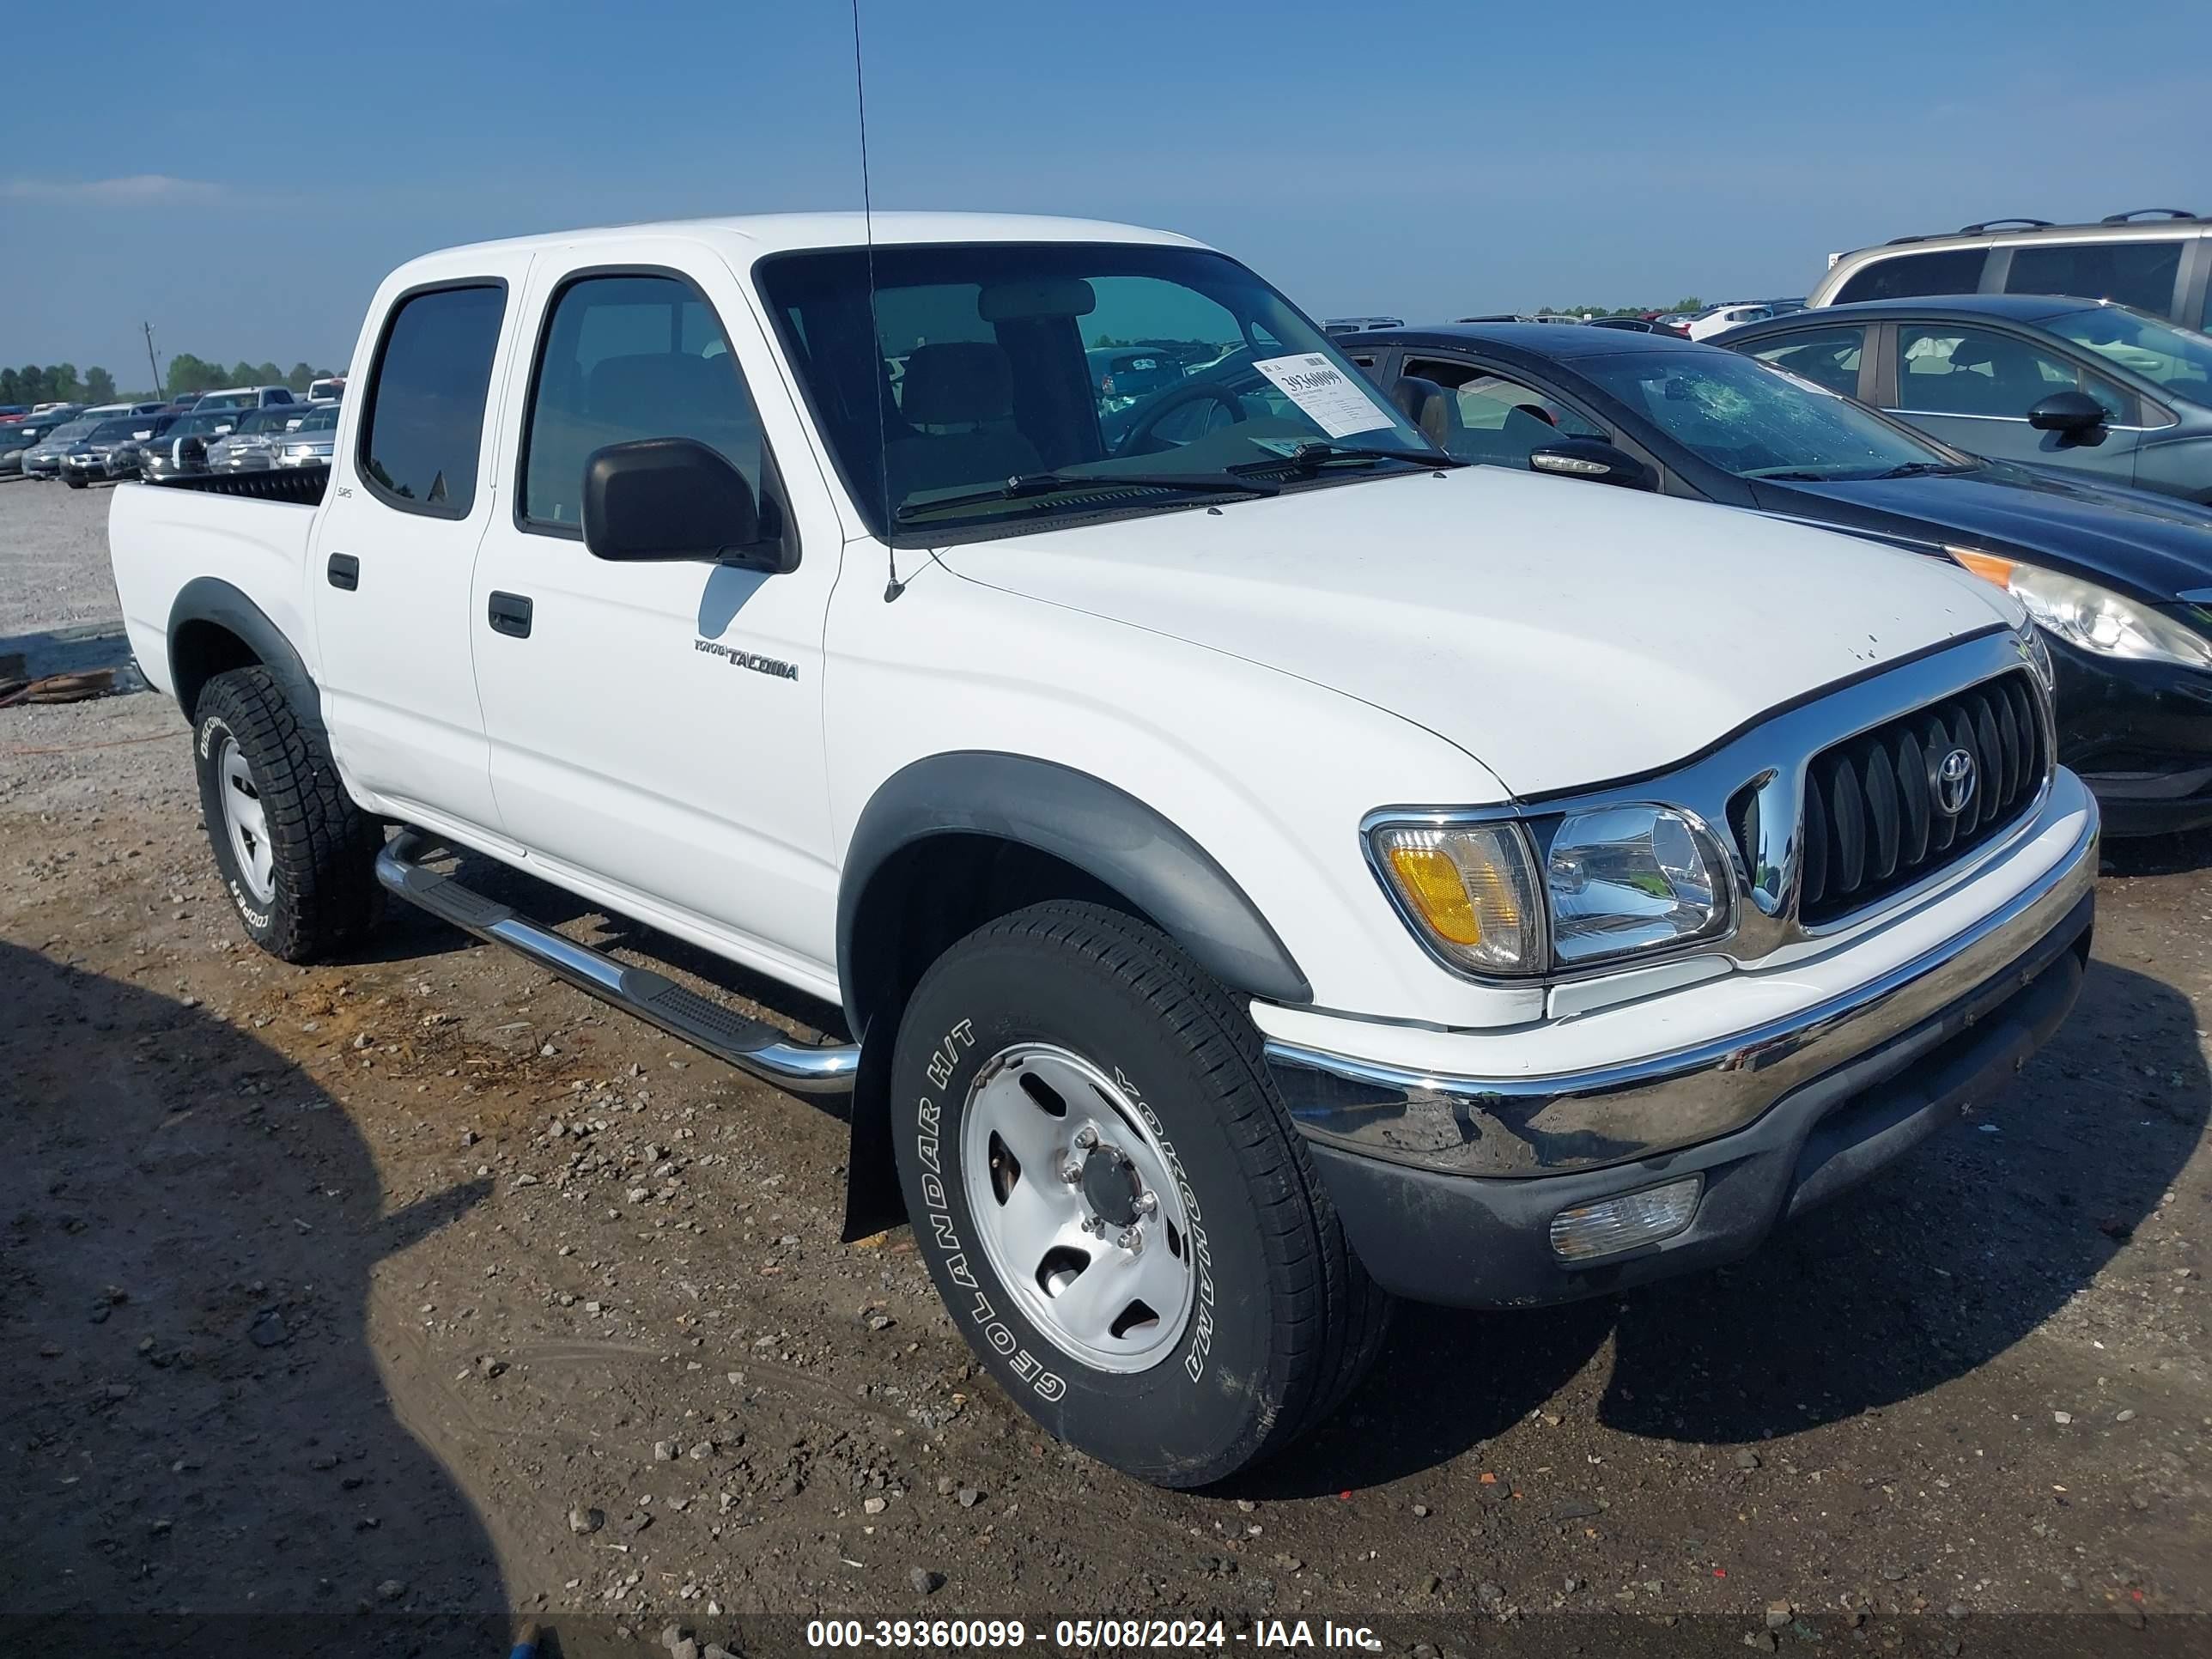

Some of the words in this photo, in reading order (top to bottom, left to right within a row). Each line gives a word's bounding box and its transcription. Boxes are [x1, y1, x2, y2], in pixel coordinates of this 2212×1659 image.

[1280, 370, 1343, 392] 39360099
[727, 647, 799, 682] TACOMA
[229, 878, 269, 928] COOPER
[925, 1018, 977, 1091] H/T
[913, 1096, 1067, 1403] GEOLANDAR
[1114, 1065, 1217, 1384] YOKOHAMA
